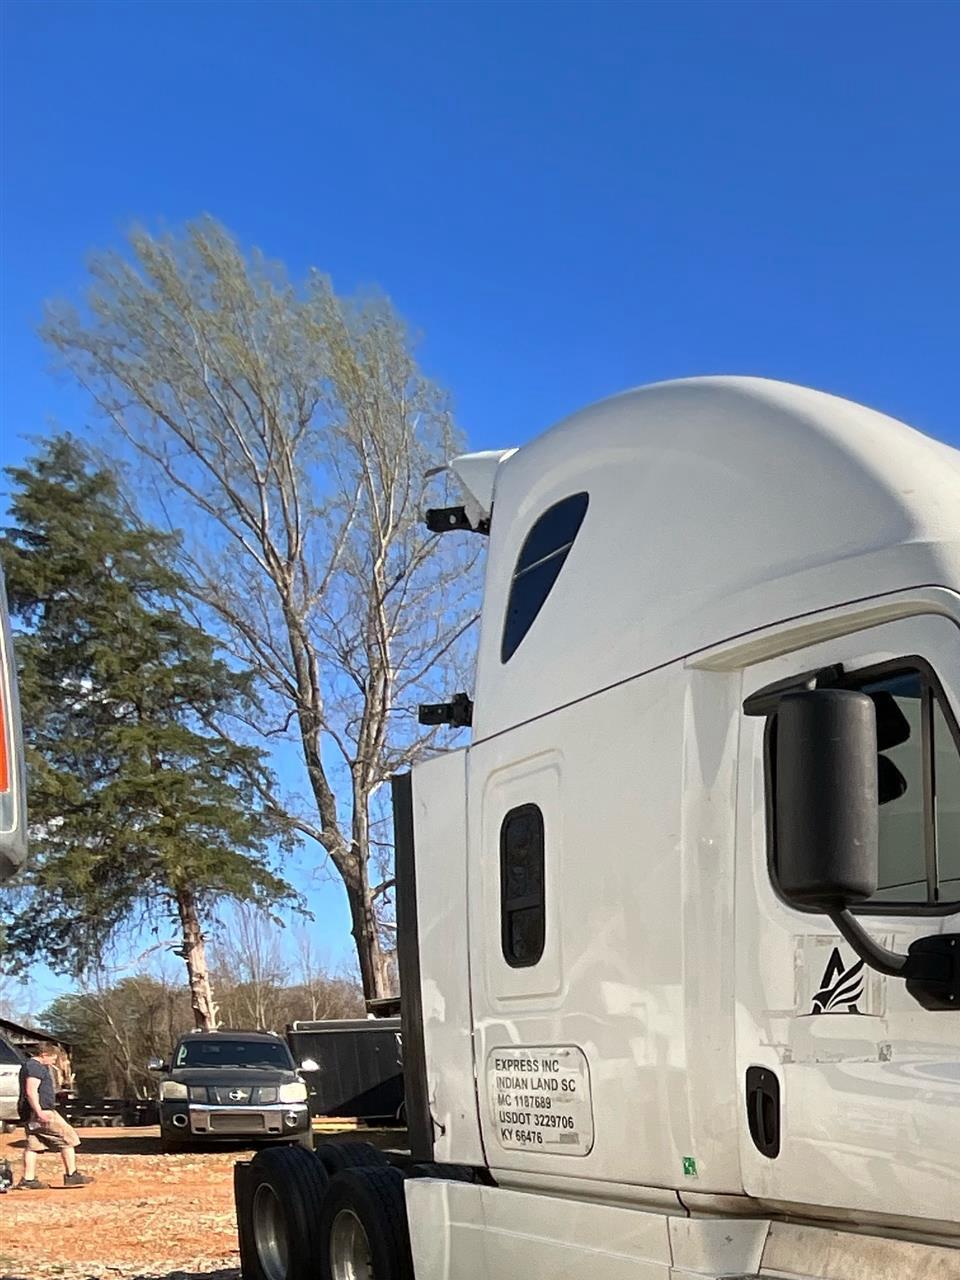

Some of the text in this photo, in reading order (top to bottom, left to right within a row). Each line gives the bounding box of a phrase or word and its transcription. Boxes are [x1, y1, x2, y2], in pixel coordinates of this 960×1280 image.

[495, 1058, 560, 1073] EXPRESS INC
[496, 1076, 576, 1092] INDIAN LAND SC
[497, 1093, 512, 1107] MC
[499, 1110, 574, 1129] USDOT 3229706
[501, 1128, 513, 1140] KY
